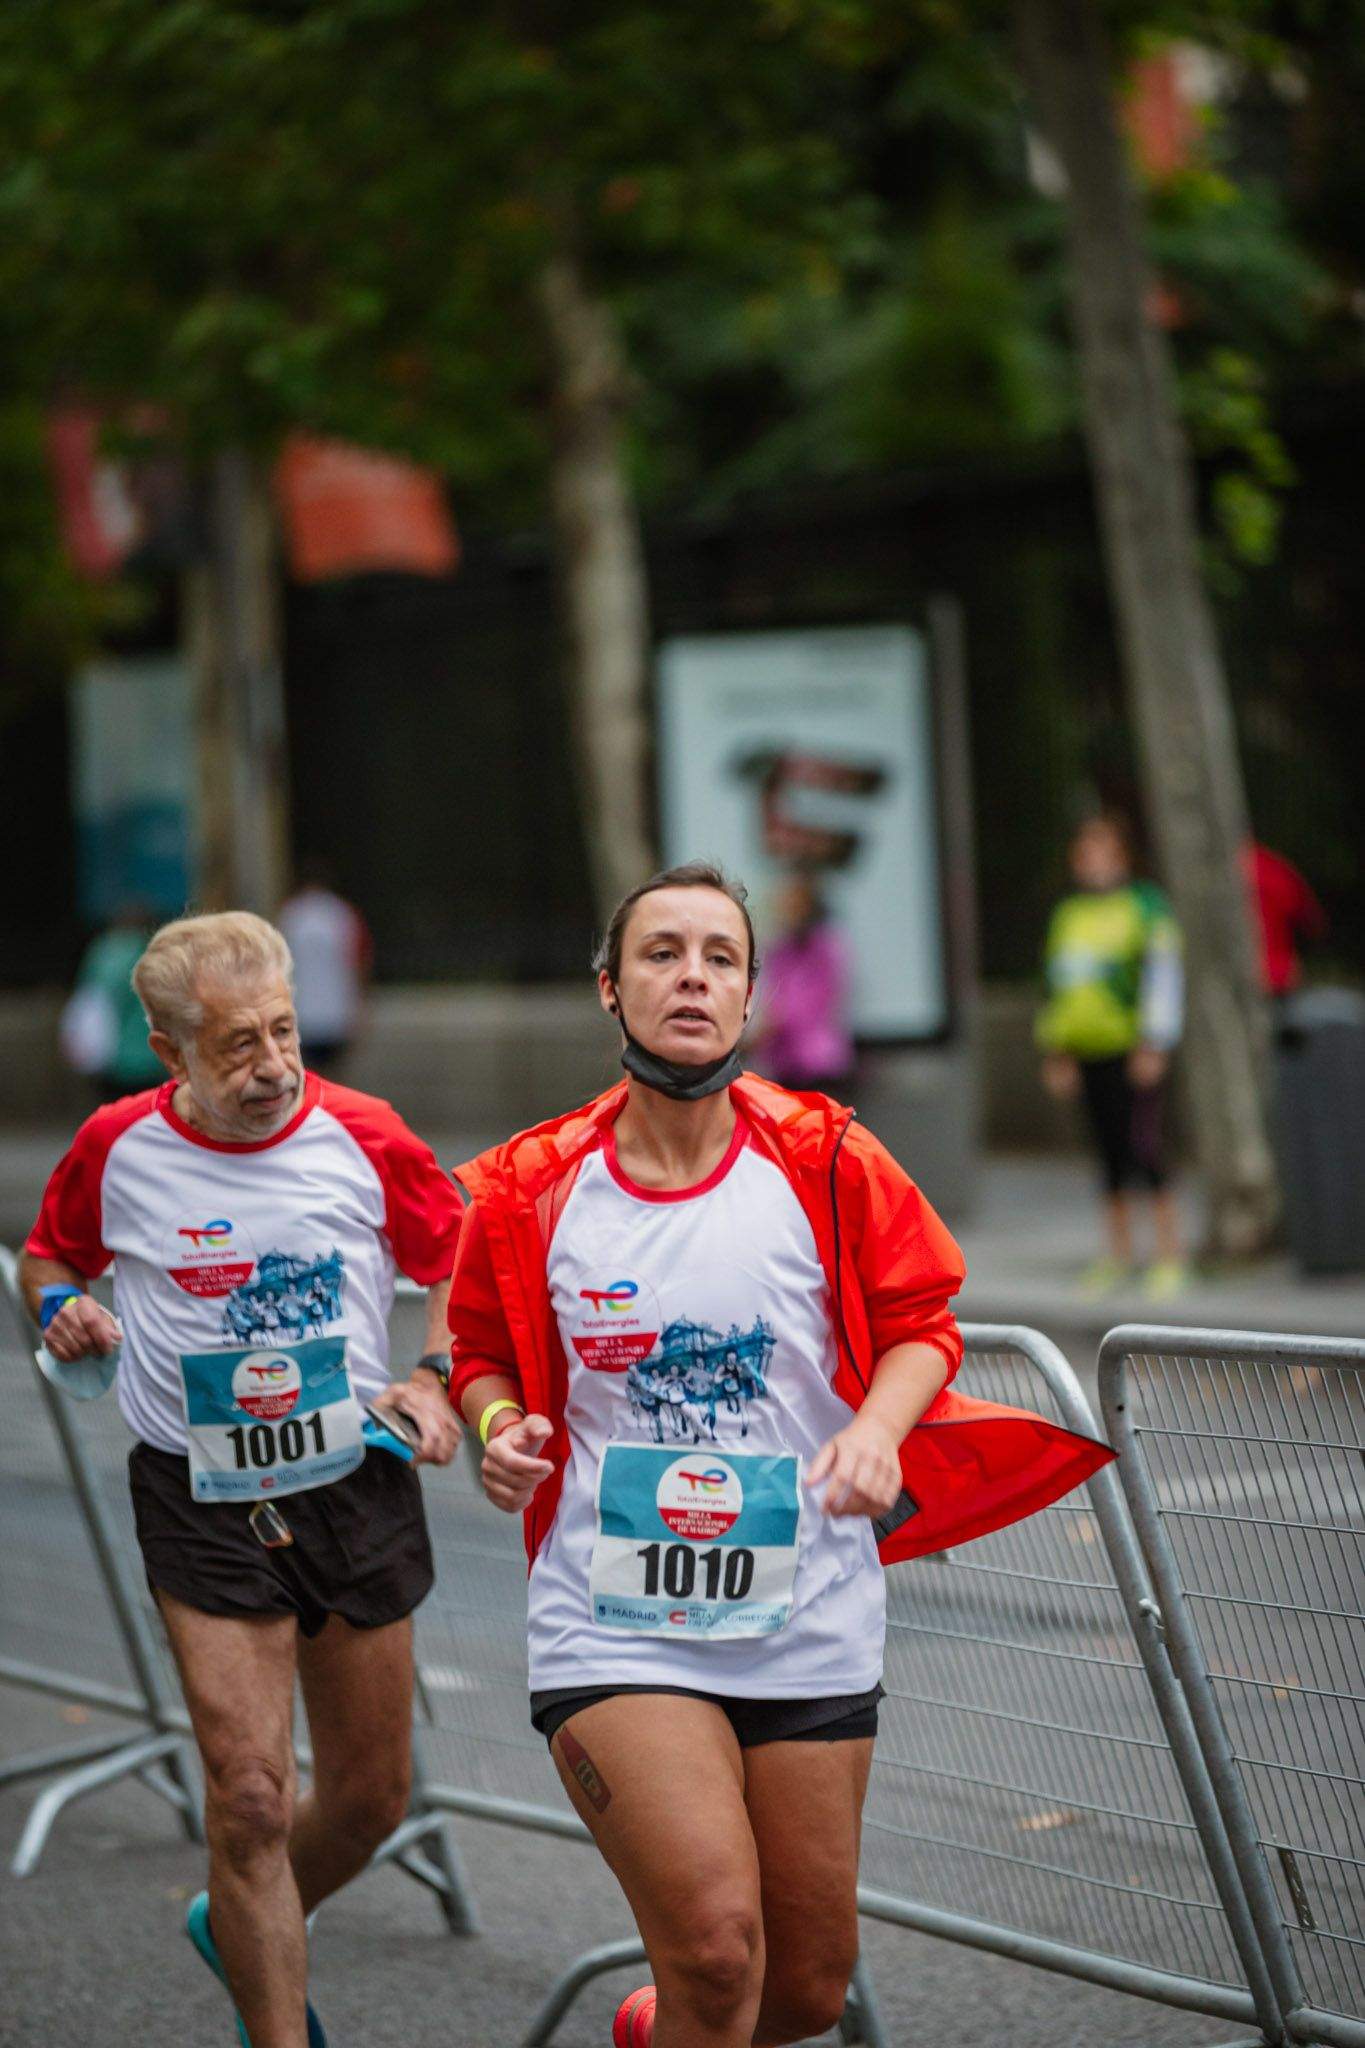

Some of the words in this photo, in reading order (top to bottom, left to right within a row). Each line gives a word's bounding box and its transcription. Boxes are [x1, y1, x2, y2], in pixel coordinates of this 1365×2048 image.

[226, 1412, 326, 1470] 1001
[637, 1543, 755, 1601] 1010
[612, 1607, 657, 1621] MADRID
